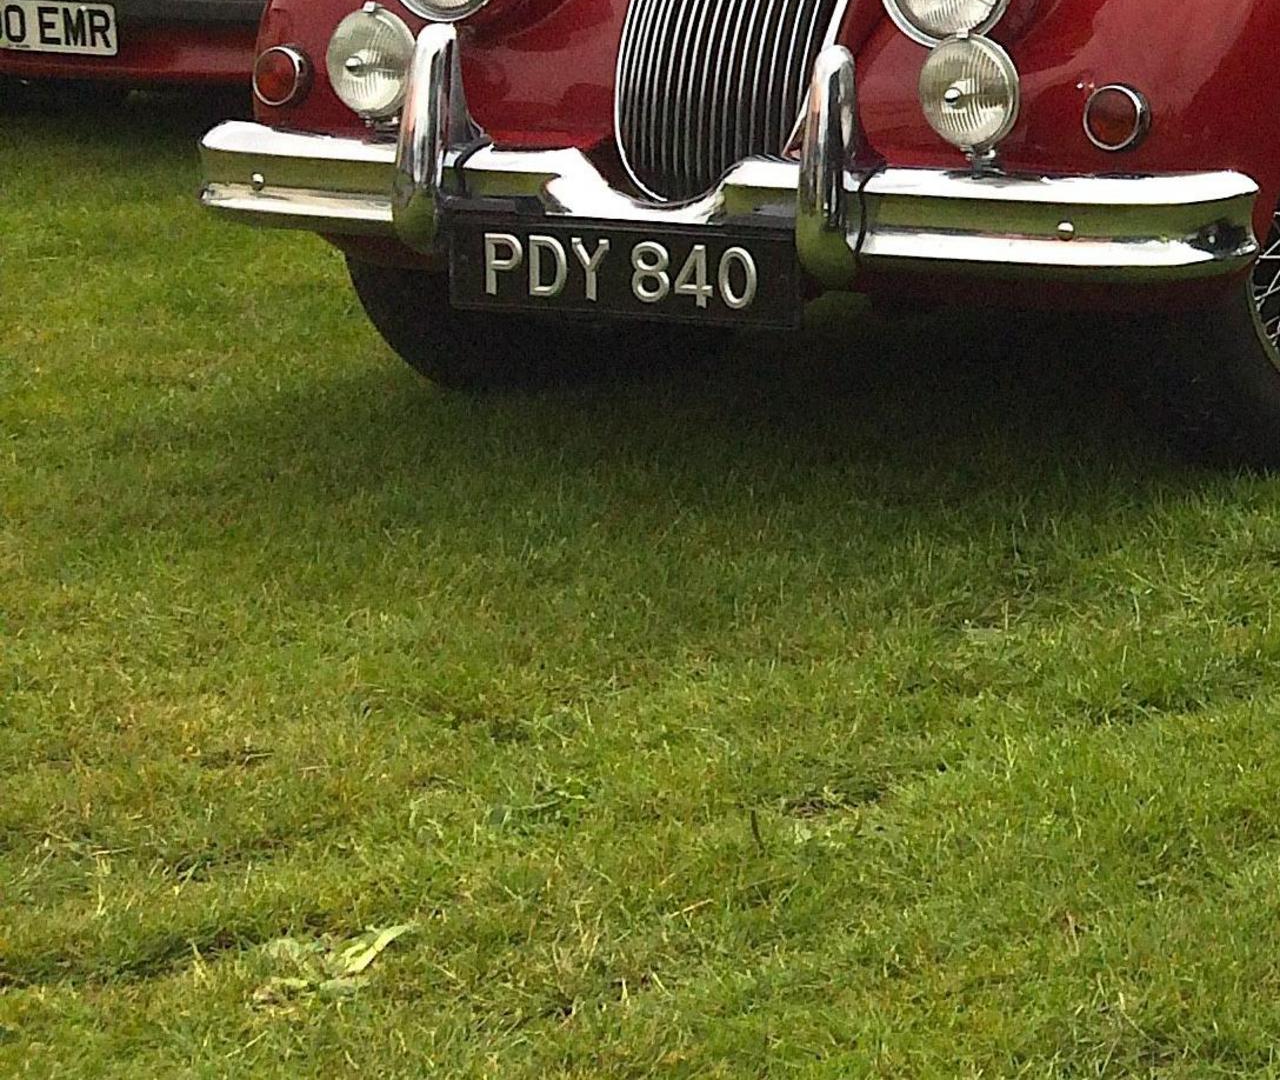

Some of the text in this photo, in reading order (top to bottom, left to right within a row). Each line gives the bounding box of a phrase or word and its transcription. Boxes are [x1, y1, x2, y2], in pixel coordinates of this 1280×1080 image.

[37, 6, 112, 49] EMR
[484, 233, 758, 310] PDY 840
